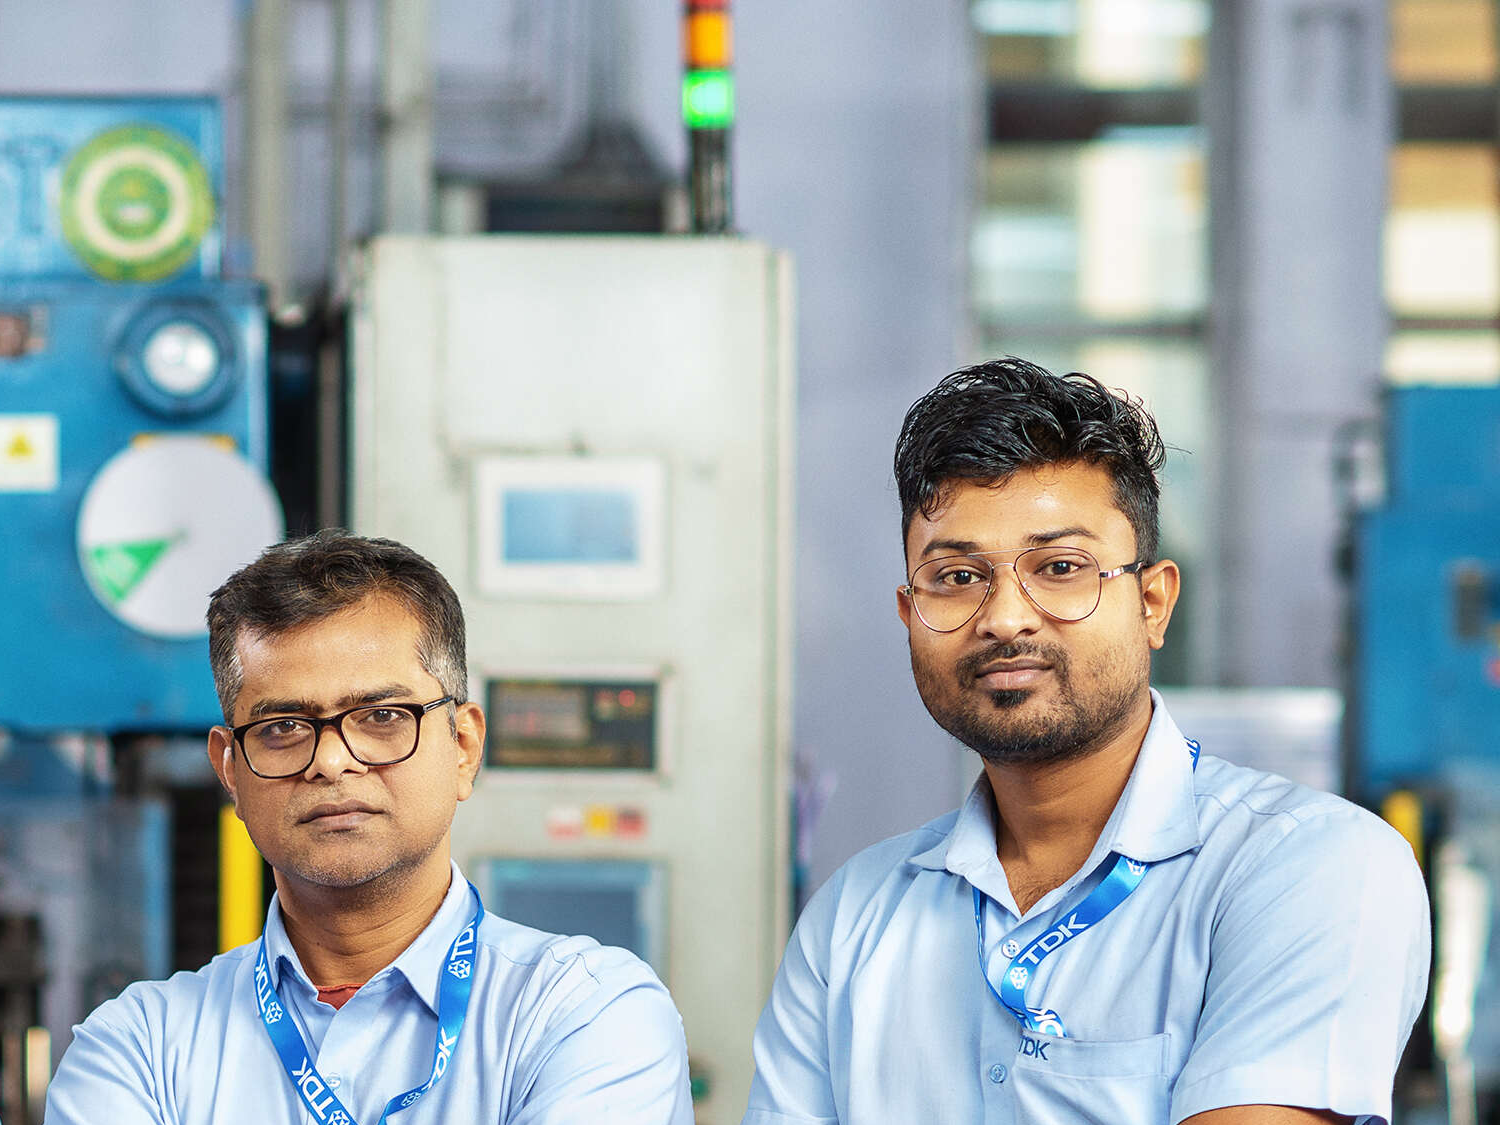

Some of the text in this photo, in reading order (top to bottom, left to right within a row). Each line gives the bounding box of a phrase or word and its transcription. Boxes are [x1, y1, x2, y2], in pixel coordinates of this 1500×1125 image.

[449, 920, 476, 961] TD
[1017, 912, 1089, 965] TDK
[255, 952, 272, 1013] TDK
[291, 1056, 334, 1121] TDK
